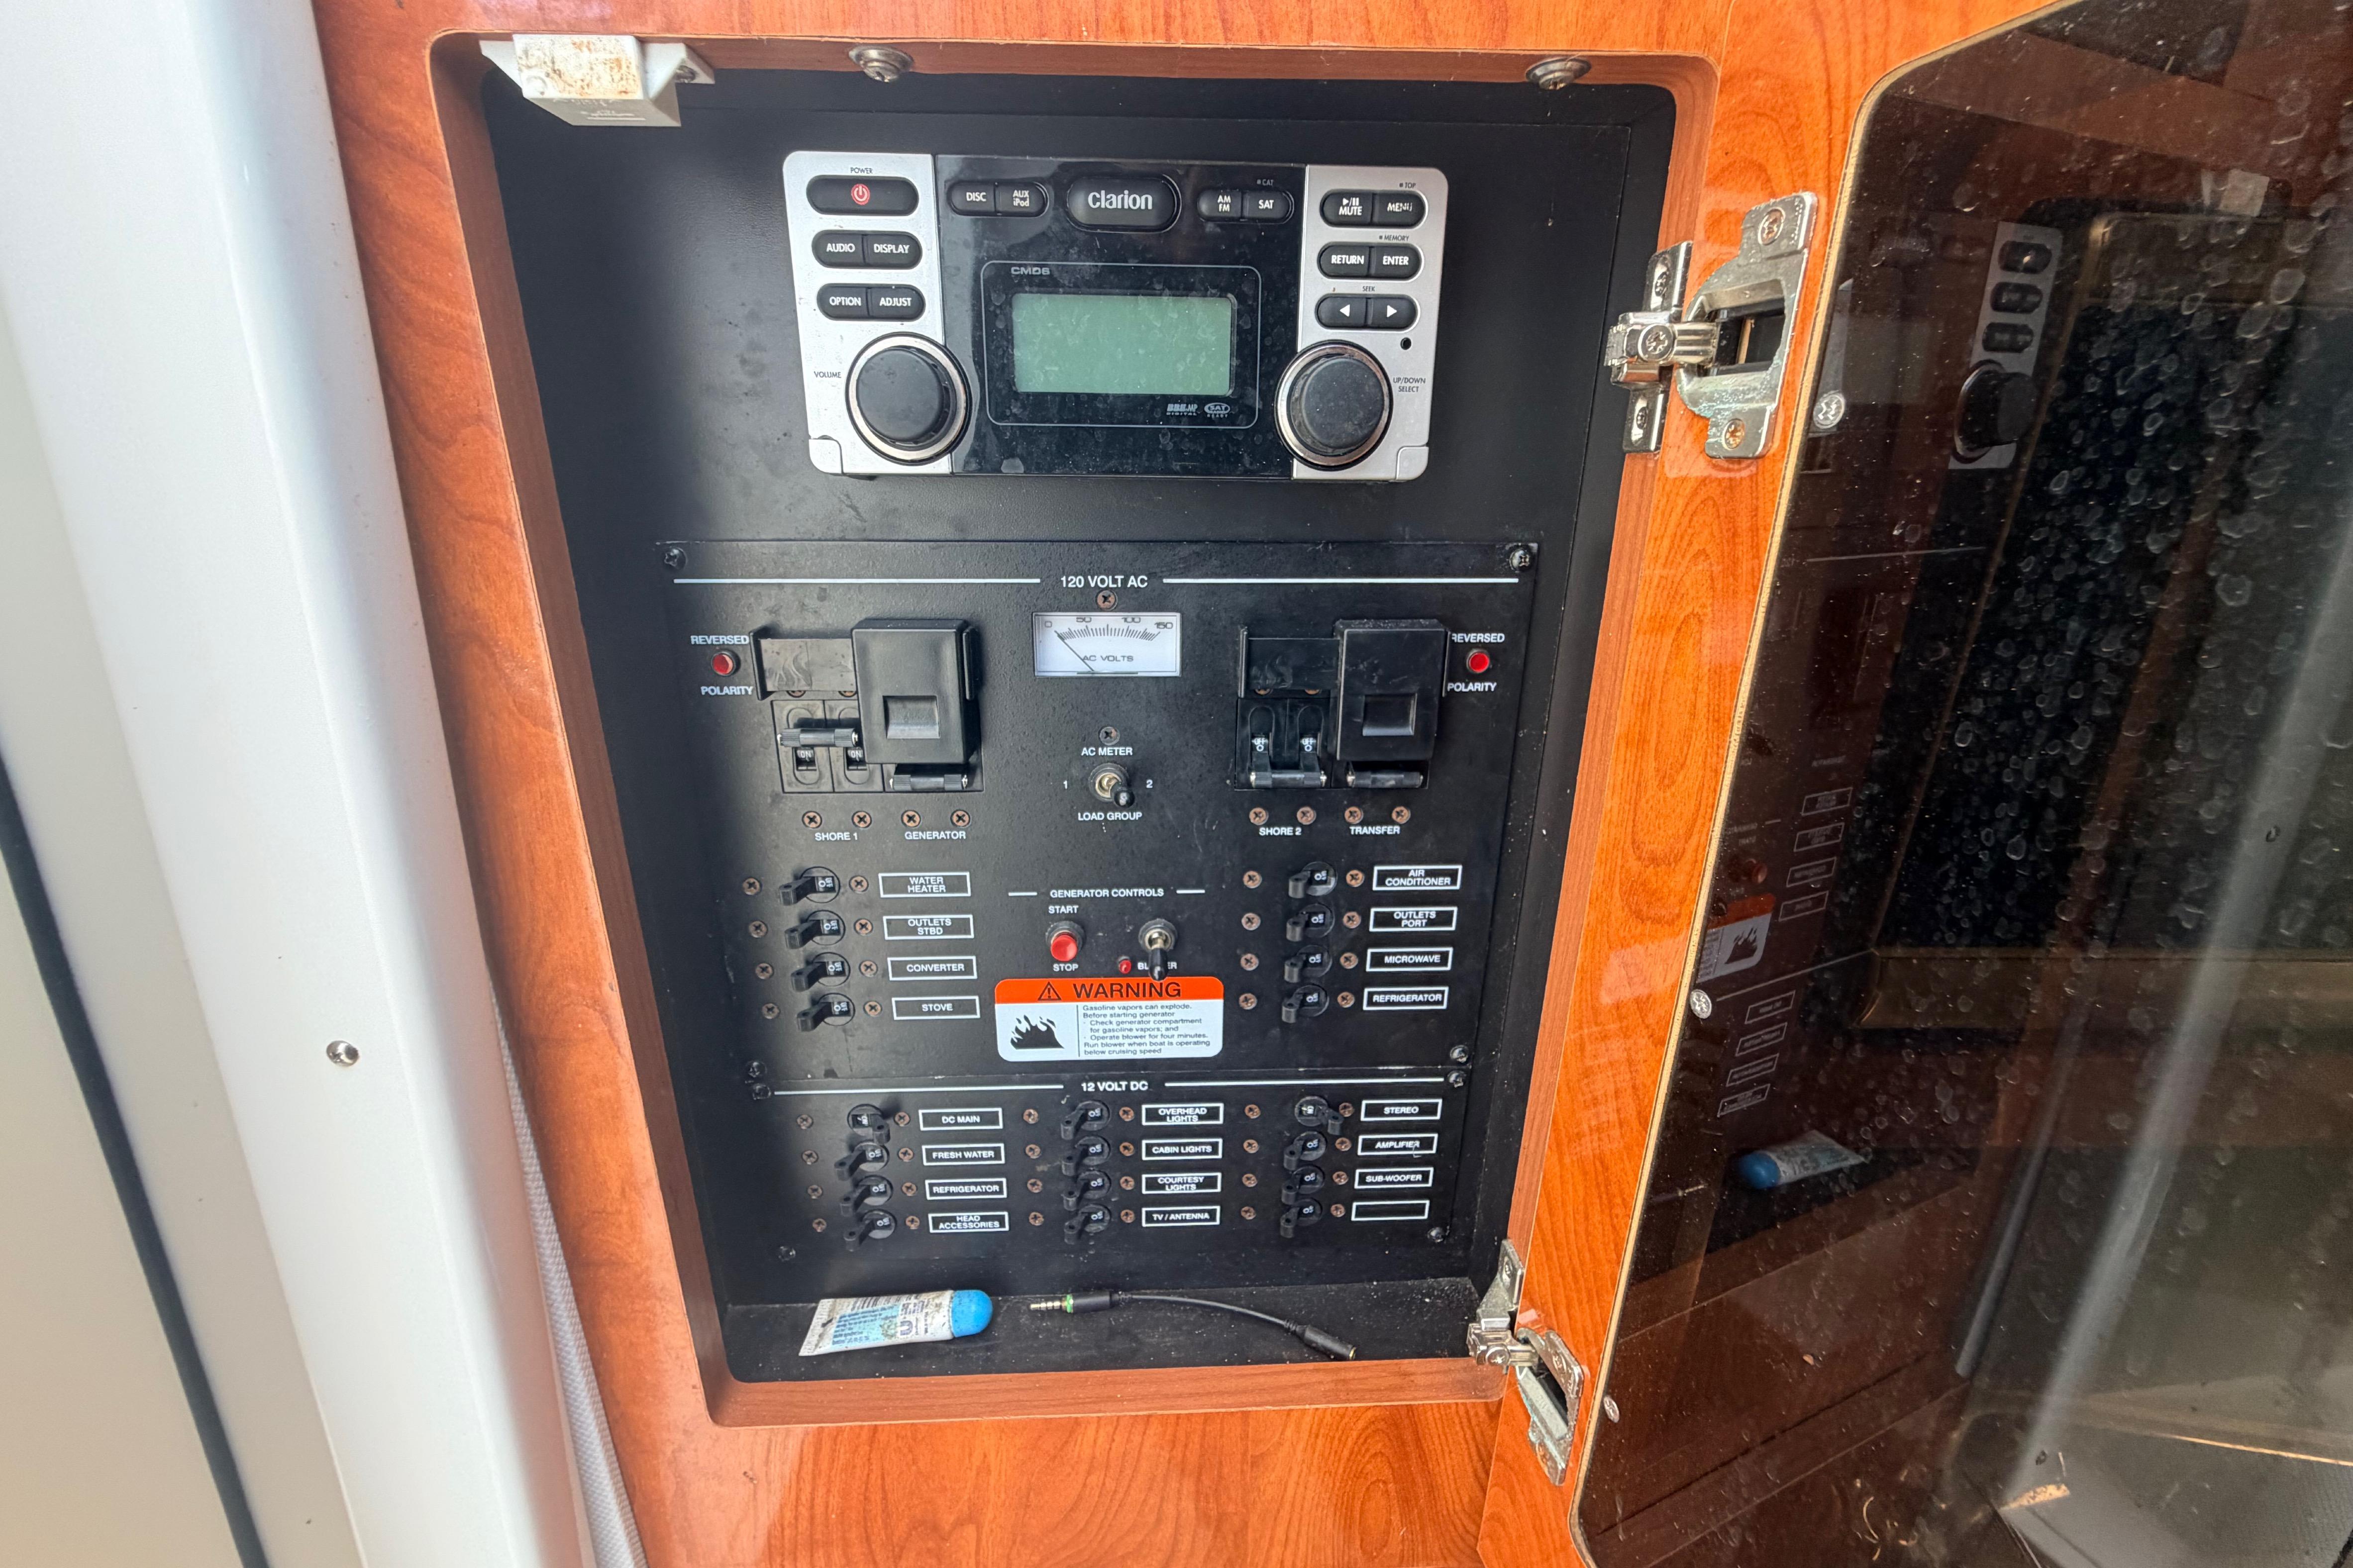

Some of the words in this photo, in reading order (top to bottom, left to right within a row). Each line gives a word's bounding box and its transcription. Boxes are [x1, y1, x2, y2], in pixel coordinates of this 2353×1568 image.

[966, 192, 987, 202] DISC
[1088, 190, 1153, 210] Clarion
[1217, 195, 1231, 204] AM
[1013, 197, 1029, 207] iPod
[1258, 199, 1274, 210] SAT
[1218, 203, 1230, 212] FM
[1338, 205, 1362, 215] MUTE
[1387, 202, 1413, 212] MENU
[826, 243, 855, 253] AUDIO
[873, 243, 910, 254] DISPLAY
[1331, 255, 1364, 265] RETURN
[1382, 255, 1409, 266] ENTER
[1011, 267, 1050, 276] CMD6
[829, 296, 861, 306] OPTION
[879, 297, 912, 307] ADJUST
[814, 371, 842, 379] VOLUME
[1060, 576, 1084, 588] 120
[1088, 575, 1124, 588] VOLT
[1127, 576, 1148, 588] AC
[690, 635, 749, 645] REVERSED
[1451, 633, 1505, 643] REVERSED
[700, 686, 753, 695] POLARITY
[1447, 682, 1497, 692] POLARITY
[800, 750, 812, 759] ON
[850, 750, 862, 759] ON
[1081, 747, 1096, 756] AC
[1098, 747, 1133, 756] METER
[1063, 781, 1068, 789] 1
[1146, 780, 1153, 788] 2
[1077, 812, 1105, 821] LOAD
[1106, 812, 1142, 821] GROUP
[1258, 827, 1294, 836] SHORE
[1295, 827, 1302, 836] 2
[1349, 826, 1401, 835] TRANSFER
[815, 832, 850, 841] SHORE
[853, 832, 858, 841] 1
[904, 830, 966, 841] GENERATOR
[909, 877, 944, 885] WATER
[1385, 878, 1451, 886] CONDITIONER
[907, 884, 946, 893] HEATER
[1049, 889, 1110, 898] GENERATOR
[1111, 888, 1164, 897] CONTROLS
[1048, 905, 1079, 914] START
[1393, 911, 1436, 919] OUTLETS
[908, 918, 952, 927] OUTLETS
[1401, 919, 1427, 927] PORT
[917, 927, 943, 935] STBD
[1384, 955, 1440, 964] MICROWAVE
[907, 964, 964, 972] CONVERTER
[1053, 963, 1079, 972] STOP
[1137, 962, 1177, 970] BLER
[1073, 981, 1181, 999] WARNING
[1372, 994, 1442, 1003] REFRIGERATOR
[1081, 1082, 1095, 1091] 12
[1097, 1081, 1127, 1091] VOLT
[1130, 1081, 1148, 1090] DC
[1158, 1107, 1207, 1116] OVERHEAD
[941, 1115, 956, 1124] DC
[957, 1114, 981, 1123] MAIN
[1375, 1140, 1420, 1149] AMPLIFIER
[1152, 1146, 1179, 1154] CABIN
[1181, 1145, 1212, 1154] LIGHTS
[963, 1150, 995, 1159] WATER
[1157, 1176, 1205, 1184] COURTESY
[1365, 1174, 1423, 1182] SUB-WOOFER
[933, 1184, 1000, 1193] REFRIGERATOR
[1169, 1212, 1210, 1220] ANTENNA
[939, 1220, 1000, 1230] ACCESSORIES
